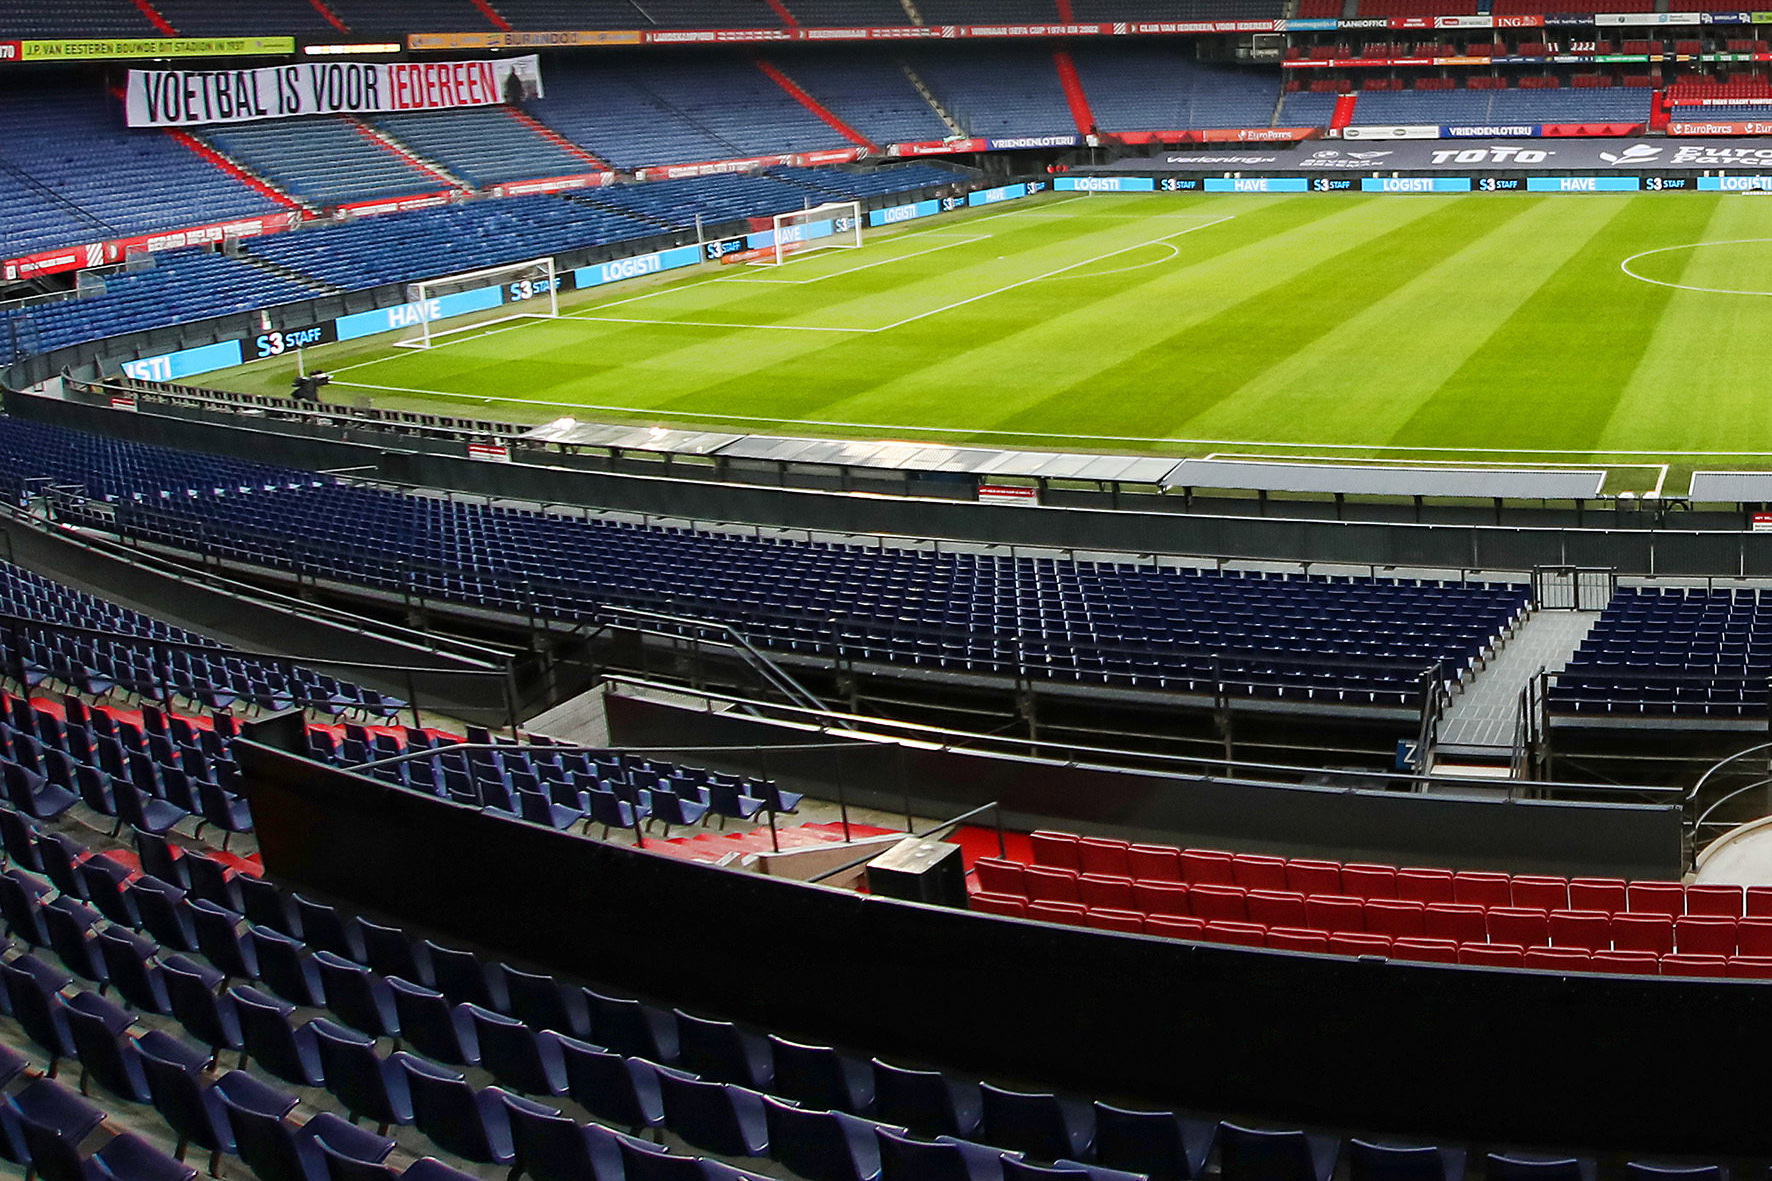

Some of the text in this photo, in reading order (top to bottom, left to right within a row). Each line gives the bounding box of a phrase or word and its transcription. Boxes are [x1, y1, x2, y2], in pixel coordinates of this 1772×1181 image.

[1498, 18, 1520, 27] ING
[1030, 25, 1045, 34] CUP
[43, 44, 61, 55] VAN
[65, 42, 112, 54] EESTEREN
[145, 62, 498, 122] VOETBAL IS VOOR IEDEREEN
[1247, 130, 1292, 140] EuroParcs
[1449, 126, 1531, 137] VRIENDENLOTERIJ
[1684, 124, 1732, 135] EuroParcs
[1431, 146, 1548, 165] TOTO
[1074, 178, 1119, 190] LOGISTI
[1161, 179, 1195, 191] S3 STAFF
[1234, 179, 1267, 191] HAVE
[1313, 179, 1350, 191] S3 STAFF
[1383, 178, 1433, 190] LOGISTI
[1479, 178, 1517, 191] S3 STAFF
[1560, 178, 1596, 190] HAVE
[1646, 177, 1685, 190] S3 STAFF
[1720, 177, 1772, 190] LOGISTI
[986, 188, 1004, 201] HAVE
[884, 206, 915, 223] LOGISTI
[707, 240, 741, 259] S3 STAFF
[602, 255, 660, 282] LOGISTI
[510, 281, 533, 302] S3
[387, 300, 442, 328] HAVE
[256, 327, 322, 358] S3 STAFF
[1404, 744, 1417, 764] Z
